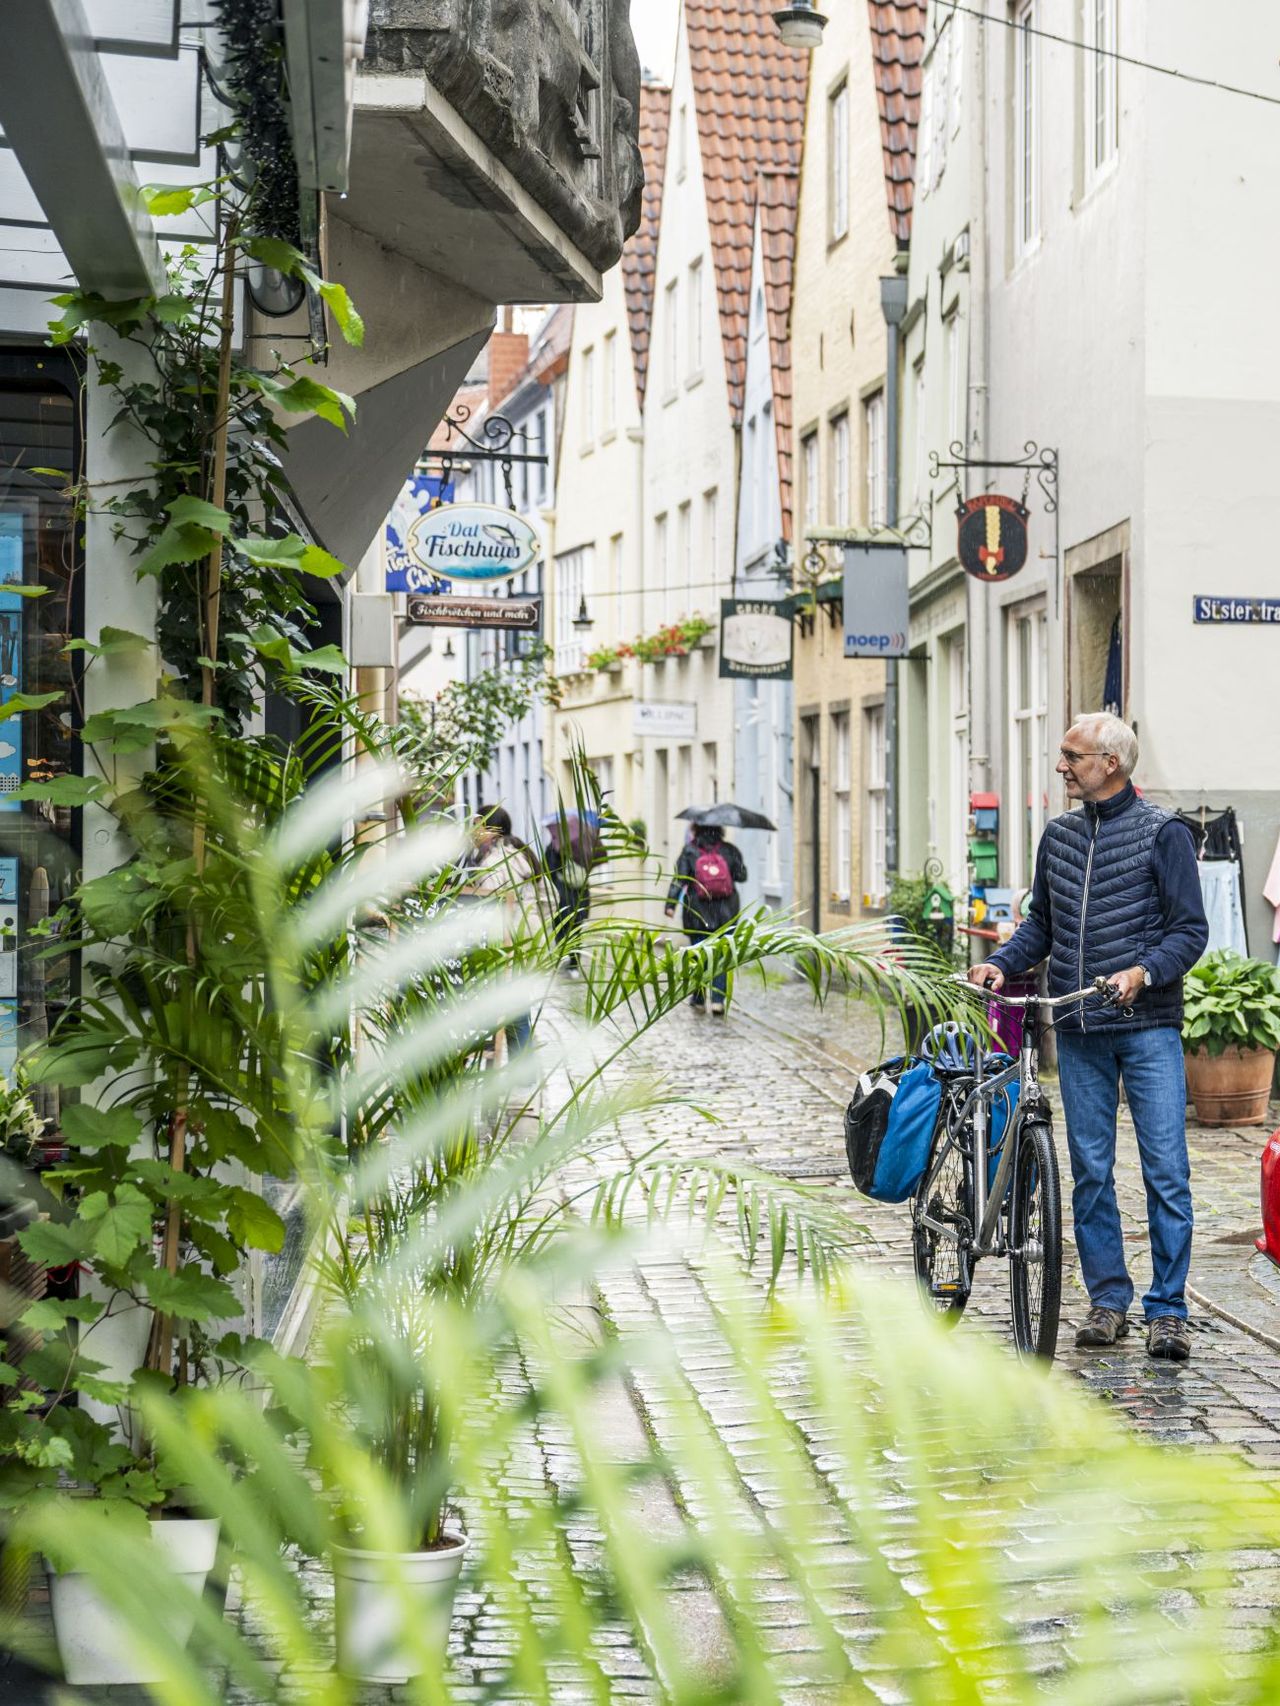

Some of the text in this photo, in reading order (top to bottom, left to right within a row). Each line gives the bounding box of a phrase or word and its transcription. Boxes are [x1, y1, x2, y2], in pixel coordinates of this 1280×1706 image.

[425, 535, 520, 560] Fischhuus
[483, 608, 502, 618] und
[847, 634, 890, 651] noep
